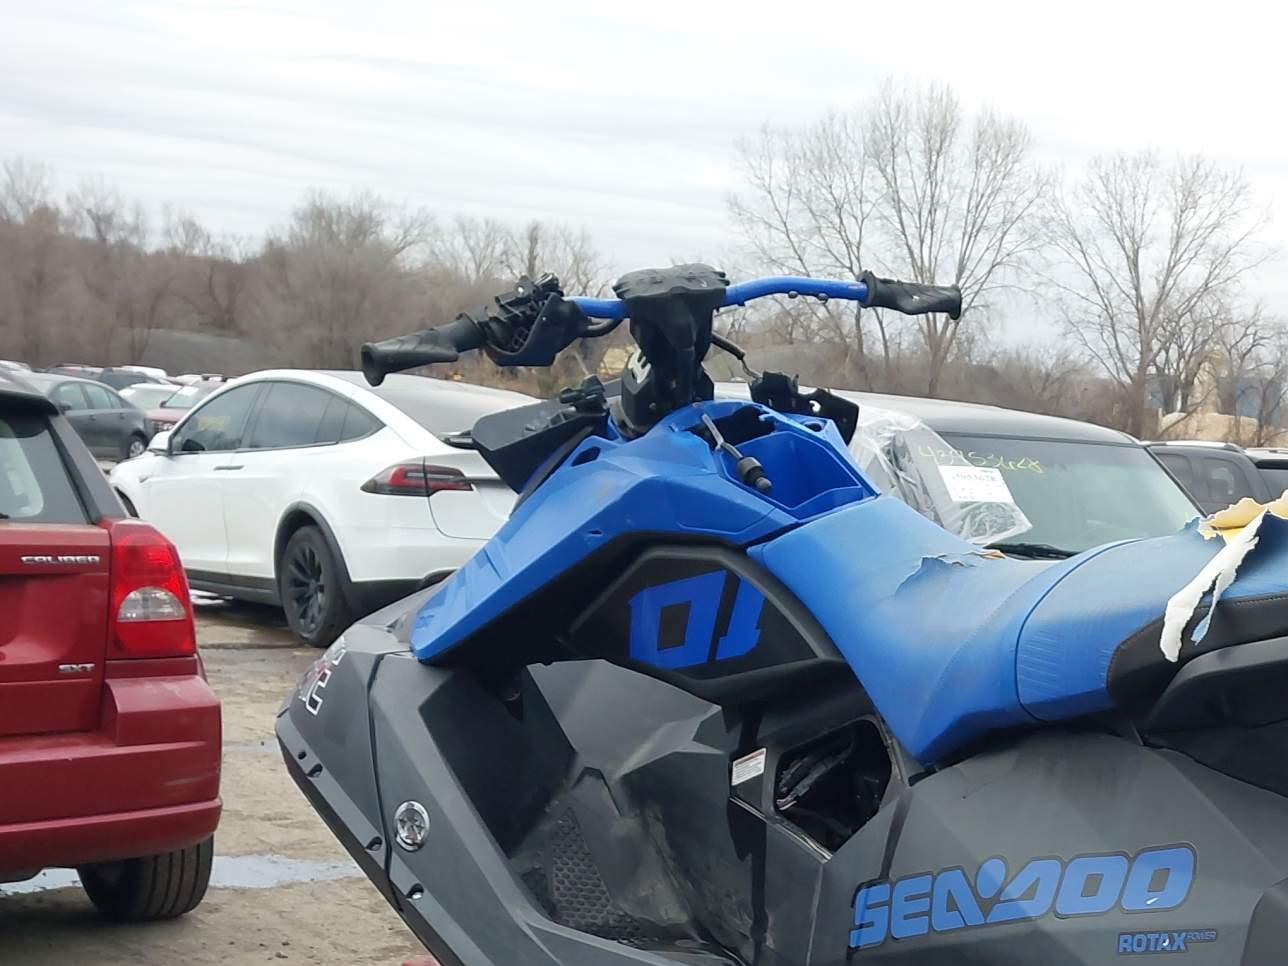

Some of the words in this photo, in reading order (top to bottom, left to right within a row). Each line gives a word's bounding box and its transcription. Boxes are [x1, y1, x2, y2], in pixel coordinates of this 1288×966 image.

[21, 555, 100, 565] CALIBER
[58, 663, 95, 673] SXT
[1119, 932, 1186, 953] ROTAX
